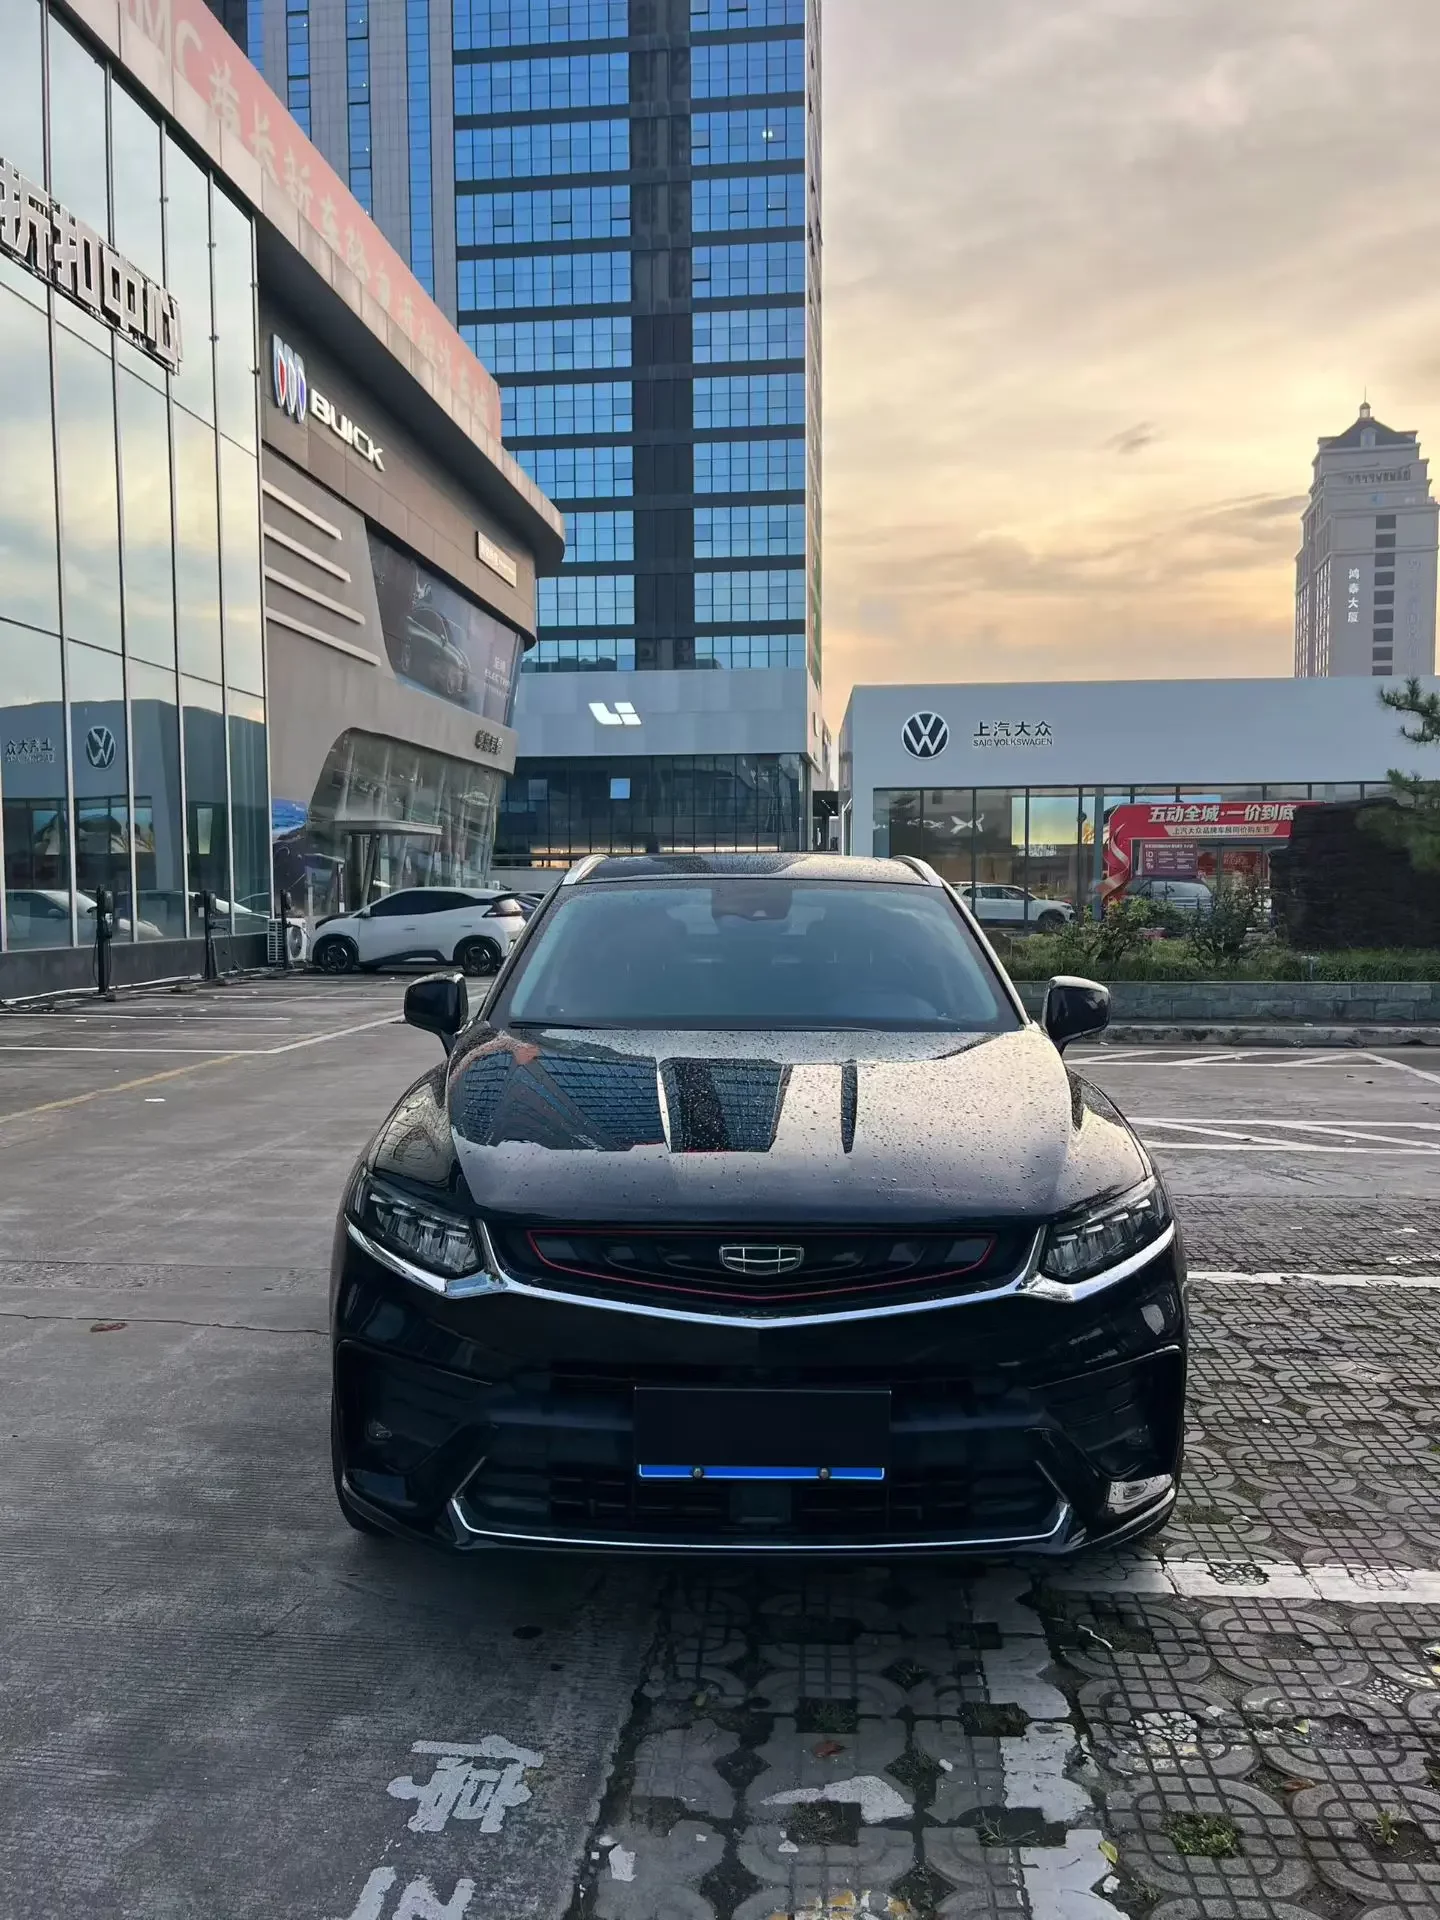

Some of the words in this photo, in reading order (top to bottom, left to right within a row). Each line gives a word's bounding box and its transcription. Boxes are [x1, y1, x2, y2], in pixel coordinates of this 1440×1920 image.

[310, 388, 386, 473] BUICK
[1347, 567, 1360, 624] 鸿泰大厦
[973, 721, 1052, 736] 上汽大众
[973, 739, 993, 747] SAIC
[993, 738, 1053, 747] VOLKSWAGEN
[1148, 804, 1296, 822] 五动全城·一价到底
